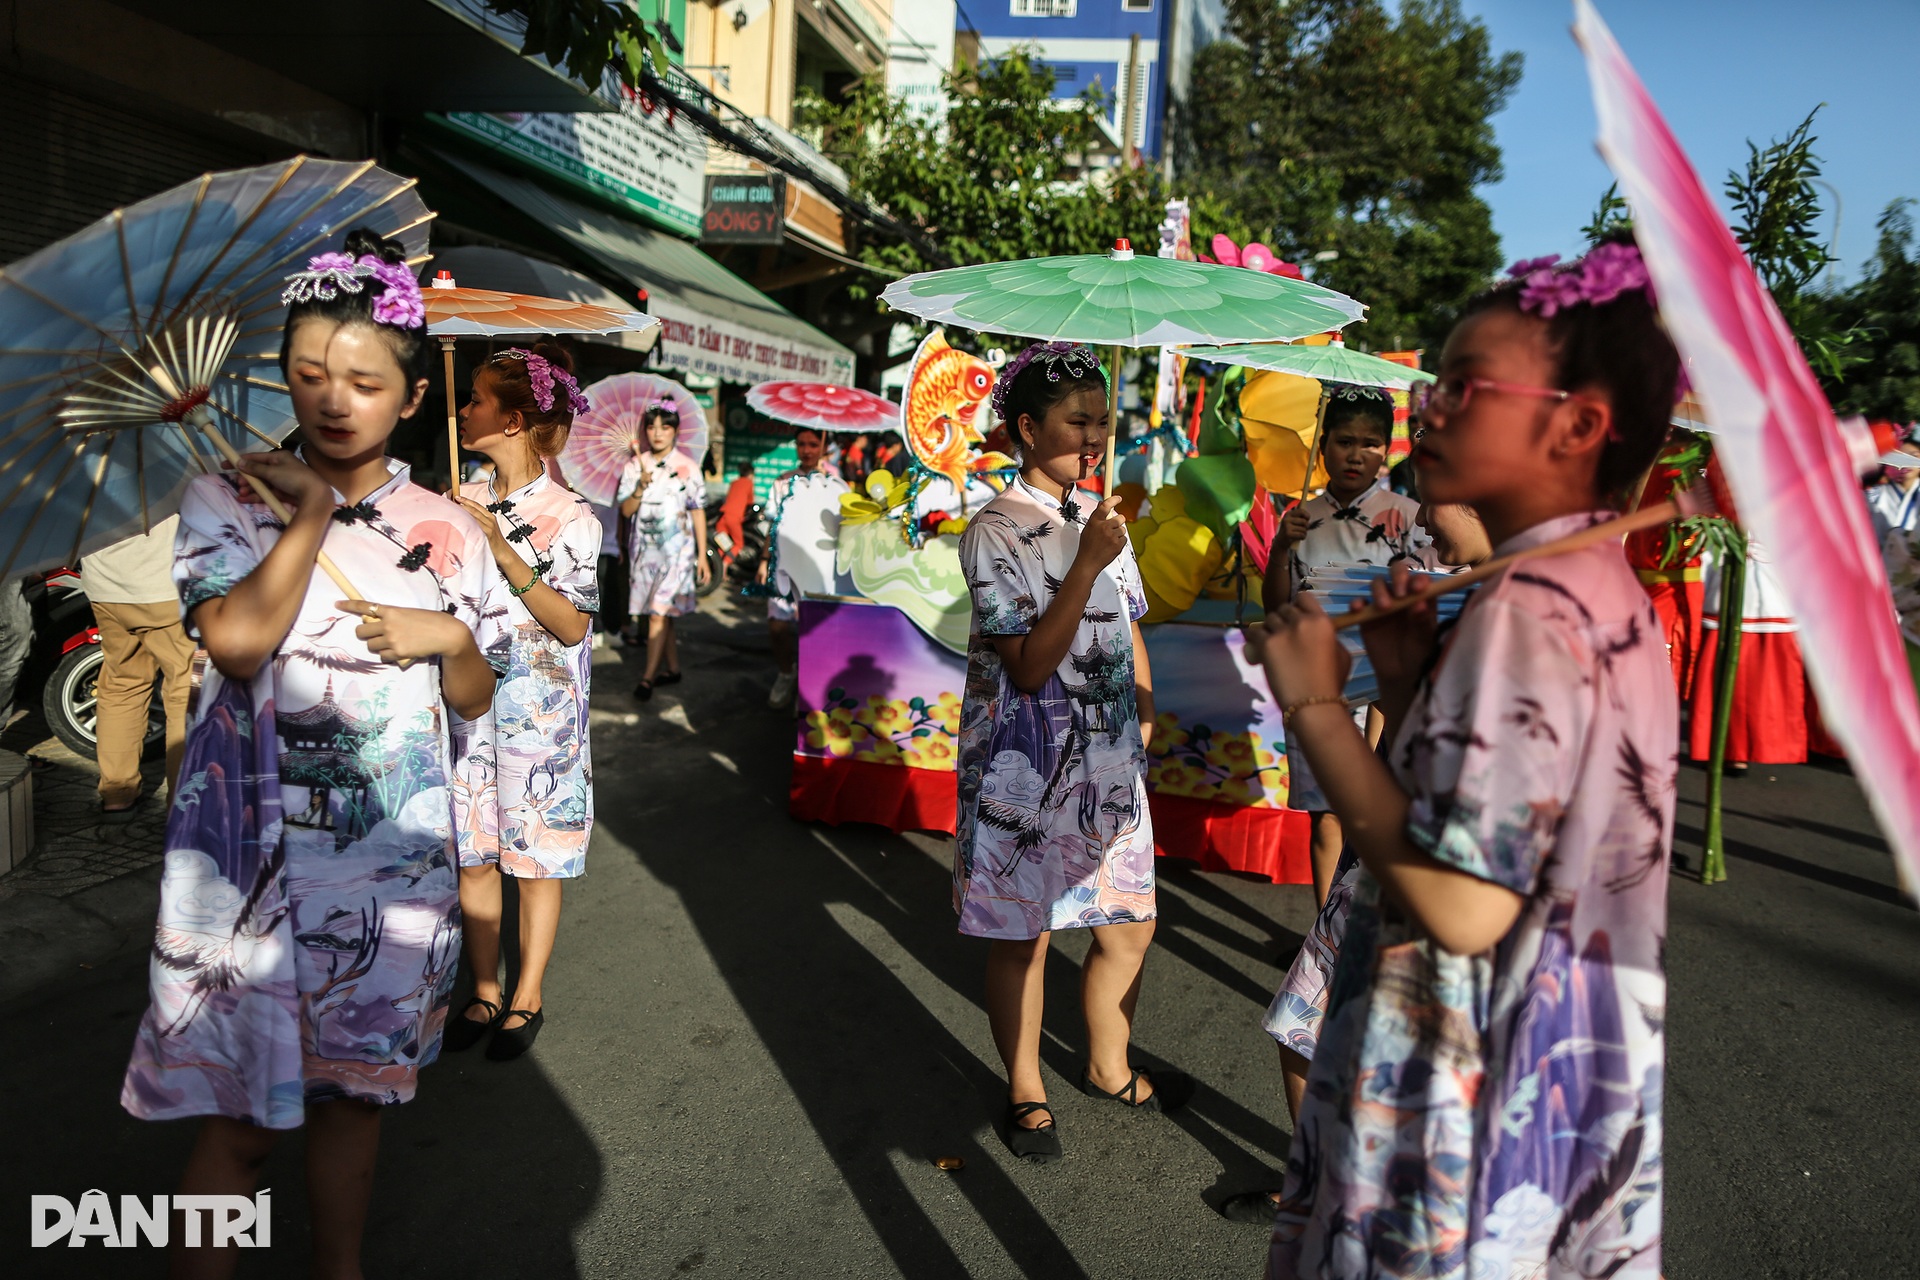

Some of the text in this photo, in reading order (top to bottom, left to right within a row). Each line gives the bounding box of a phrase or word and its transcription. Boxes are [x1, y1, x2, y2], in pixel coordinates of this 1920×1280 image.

[706, 207, 762, 232] ĐÔNG
[764, 212, 775, 233] Y
[698, 323, 721, 352] TÂM
[723, 334, 731, 355] Y
